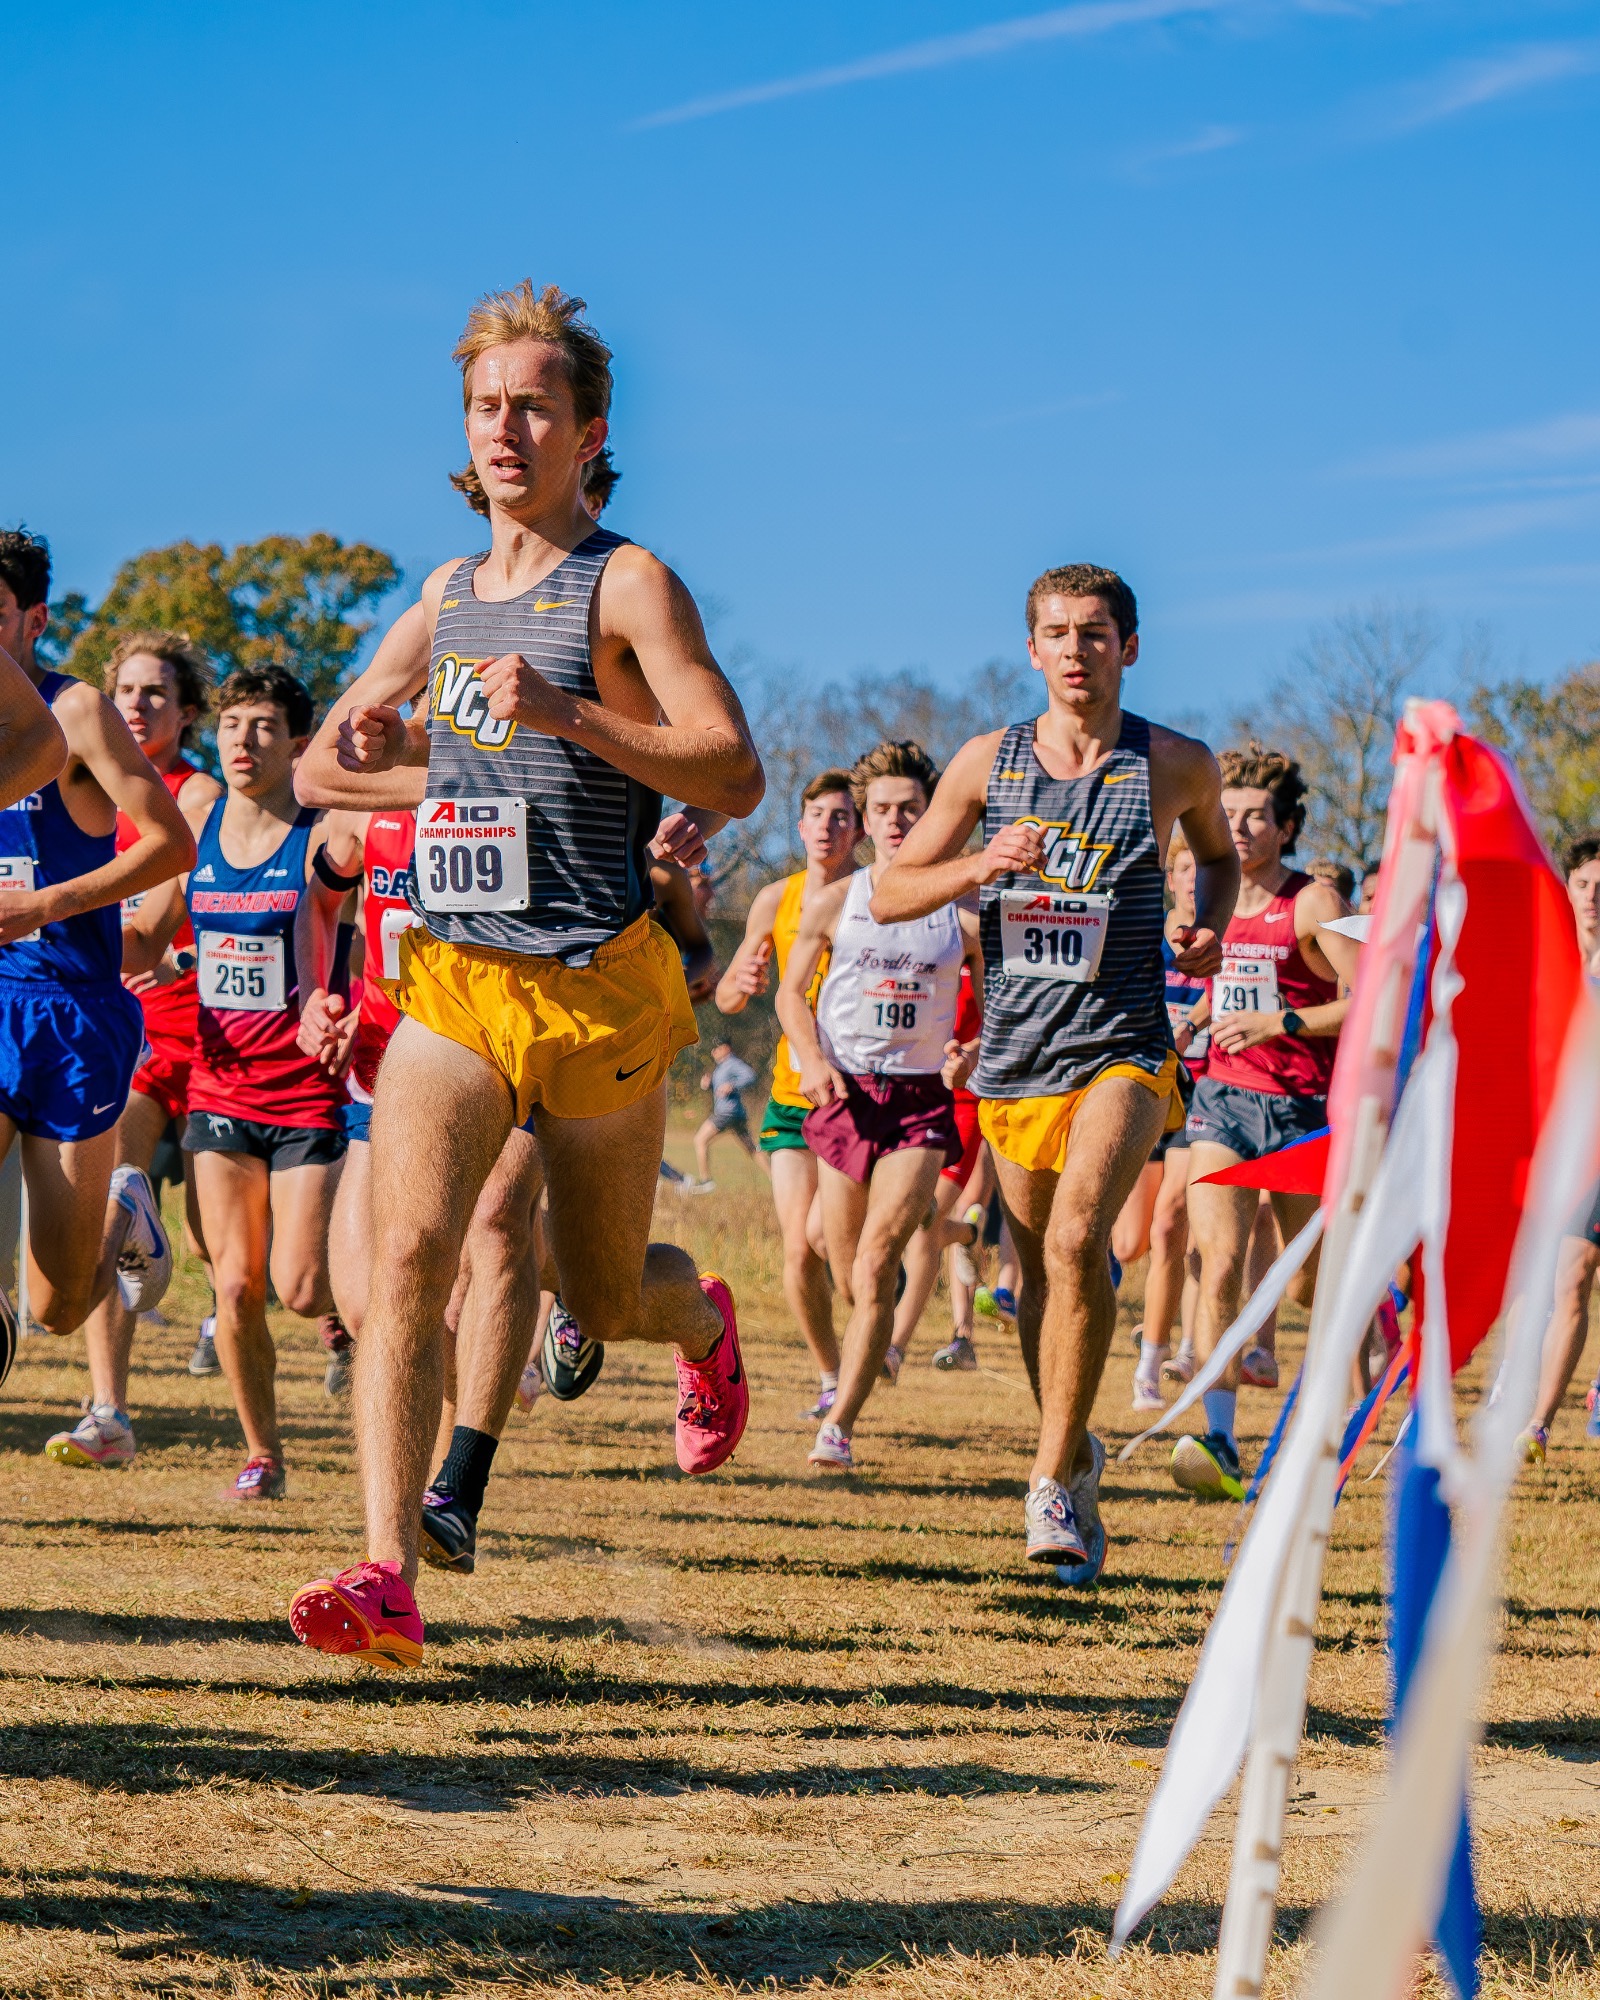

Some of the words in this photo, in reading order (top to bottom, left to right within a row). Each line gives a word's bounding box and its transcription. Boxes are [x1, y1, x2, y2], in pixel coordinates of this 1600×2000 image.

[428, 801, 499, 823] A10
[419, 826, 517, 839] CHAMPIONSHIPS
[428, 844, 503, 894] 309
[191, 890, 299, 914] RICHMOND
[1023, 895, 1088, 913] A10
[1007, 912, 1100, 927] CHAMPIONSHIPS
[218, 937, 265, 952] A10
[1023, 927, 1083, 966] 310
[856, 947, 938, 975] Fordham
[1223, 962, 1259, 974] A10
[215, 964, 266, 998] 255
[876, 979, 920, 992] A10
[1221, 986, 1259, 1011] 291
[874, 1002, 917, 1029] 198
